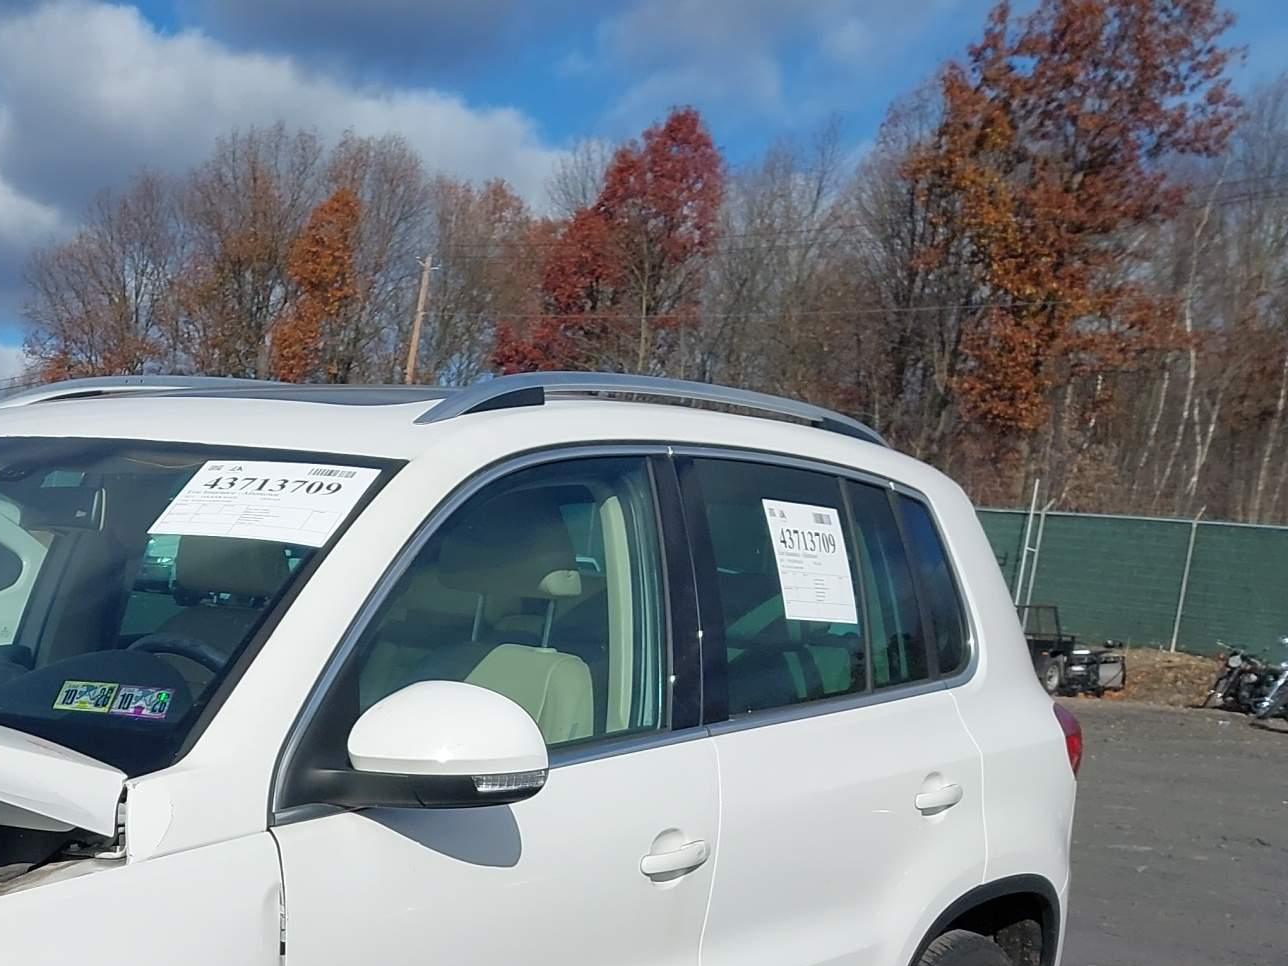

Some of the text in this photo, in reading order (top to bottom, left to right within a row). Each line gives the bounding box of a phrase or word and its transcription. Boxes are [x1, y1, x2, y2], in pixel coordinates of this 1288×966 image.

[203, 476, 343, 496] 43713709
[779, 528, 836, 554] 43713709
[62, 689, 78, 705] 10
[118, 693, 134, 709] 10
